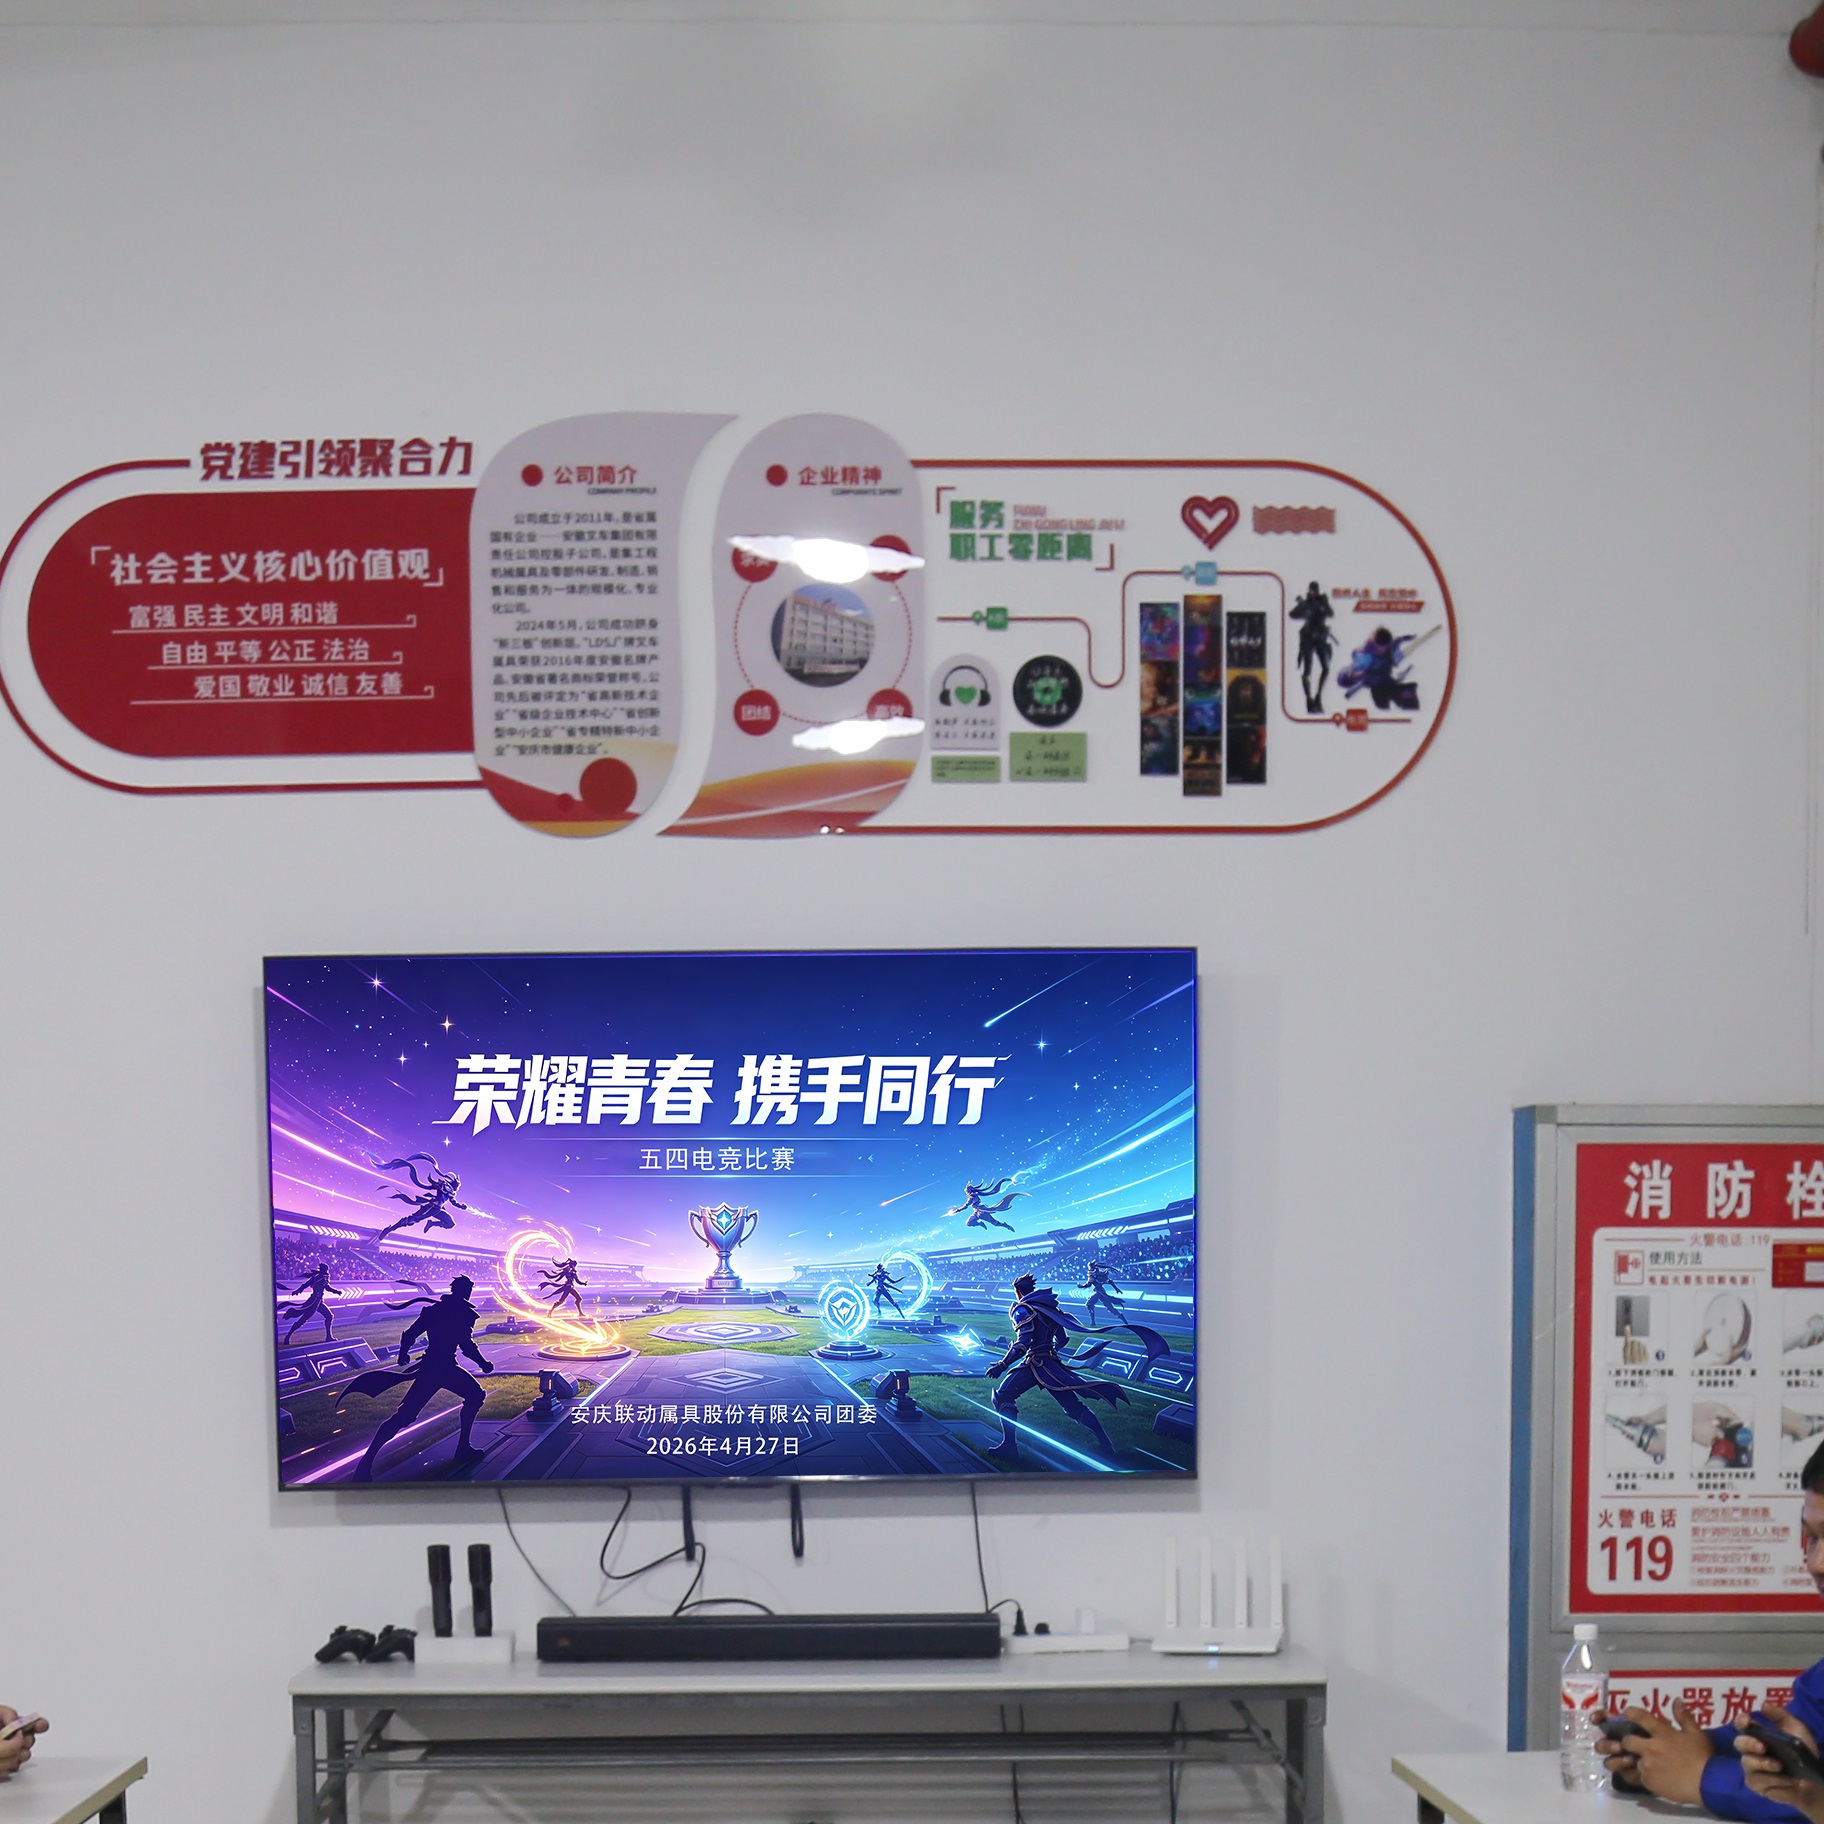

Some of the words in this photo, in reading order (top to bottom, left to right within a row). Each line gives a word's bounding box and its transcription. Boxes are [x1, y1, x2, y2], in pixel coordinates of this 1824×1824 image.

[200, 436, 474, 481] 党建引领聚合力
[554, 465, 638, 485] 公司简介
[799, 466, 882, 486] 企业精神
[949, 499, 1005, 529] 服务
[949, 532, 1093, 561] 职工零距离
[129, 603, 177, 628] 富强
[183, 603, 231, 627] 民主
[237, 602, 285, 626] 文明
[290, 601, 338, 625] 和谐
[161, 641, 209, 665] 自由
[214, 640, 262, 664] 平等
[268, 639, 317, 663] 公正
[322, 638, 371, 662] 法治
[193, 676, 242, 699] 爱国
[247, 675, 296, 697] 敬业
[301, 674, 350, 697] 诚信
[355, 673, 403, 695] 友善
[432, 1052, 714, 1135] 荣耀青春
[730, 1052, 1010, 1128] 携手同行
[638, 1146, 796, 1172] 五四电竞比赛
[1690, 1232, 1743, 1247] 火警电话
[1751, 1234, 1771, 1246] 119
[1649, 1250, 1703, 1265] 使用方法
[570, 1403, 878, 1426] 安庆联动属具股份有限公司团委
[646, 1434, 800, 1457] 2026年4月27日
[1598, 1508, 1678, 1529] 火警电话
[1600, 1535, 1674, 1583] 119
